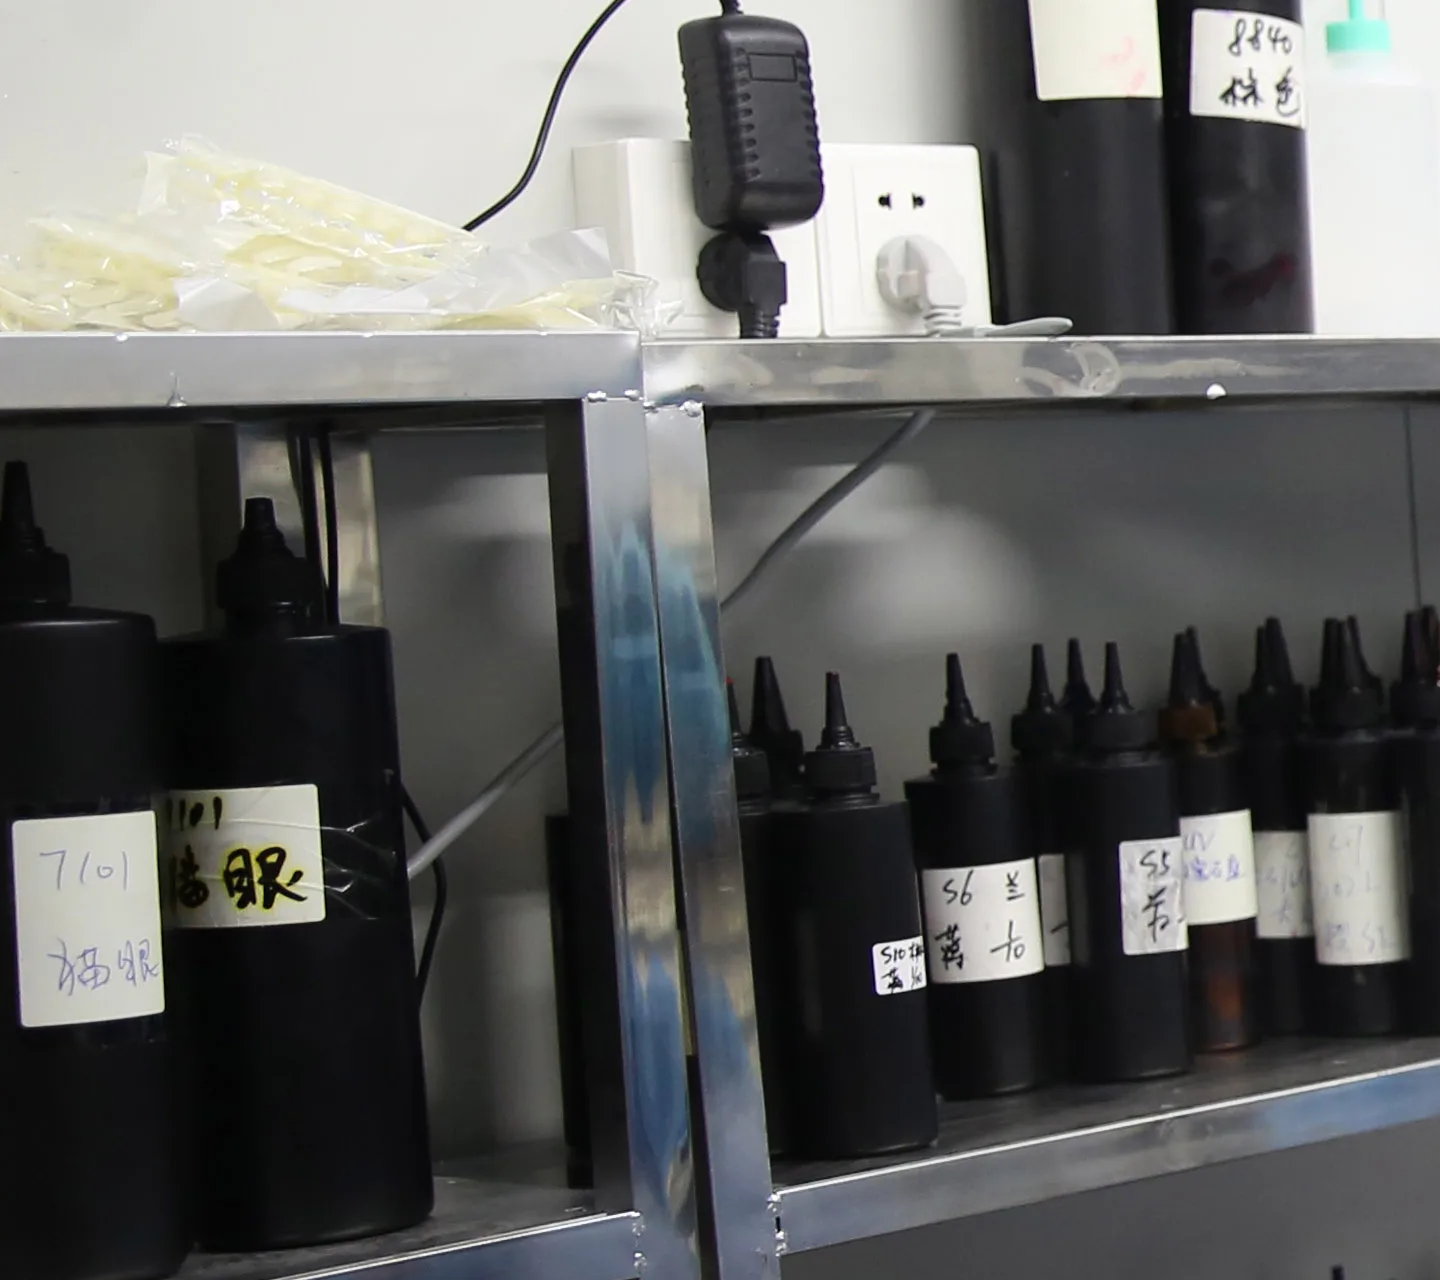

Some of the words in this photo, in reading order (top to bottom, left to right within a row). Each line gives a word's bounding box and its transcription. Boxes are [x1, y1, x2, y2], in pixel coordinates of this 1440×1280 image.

[1228, 18, 1293, 57] 8840
[38, 849, 131, 891] 7101
[46, 937, 161, 997] 猫眼
